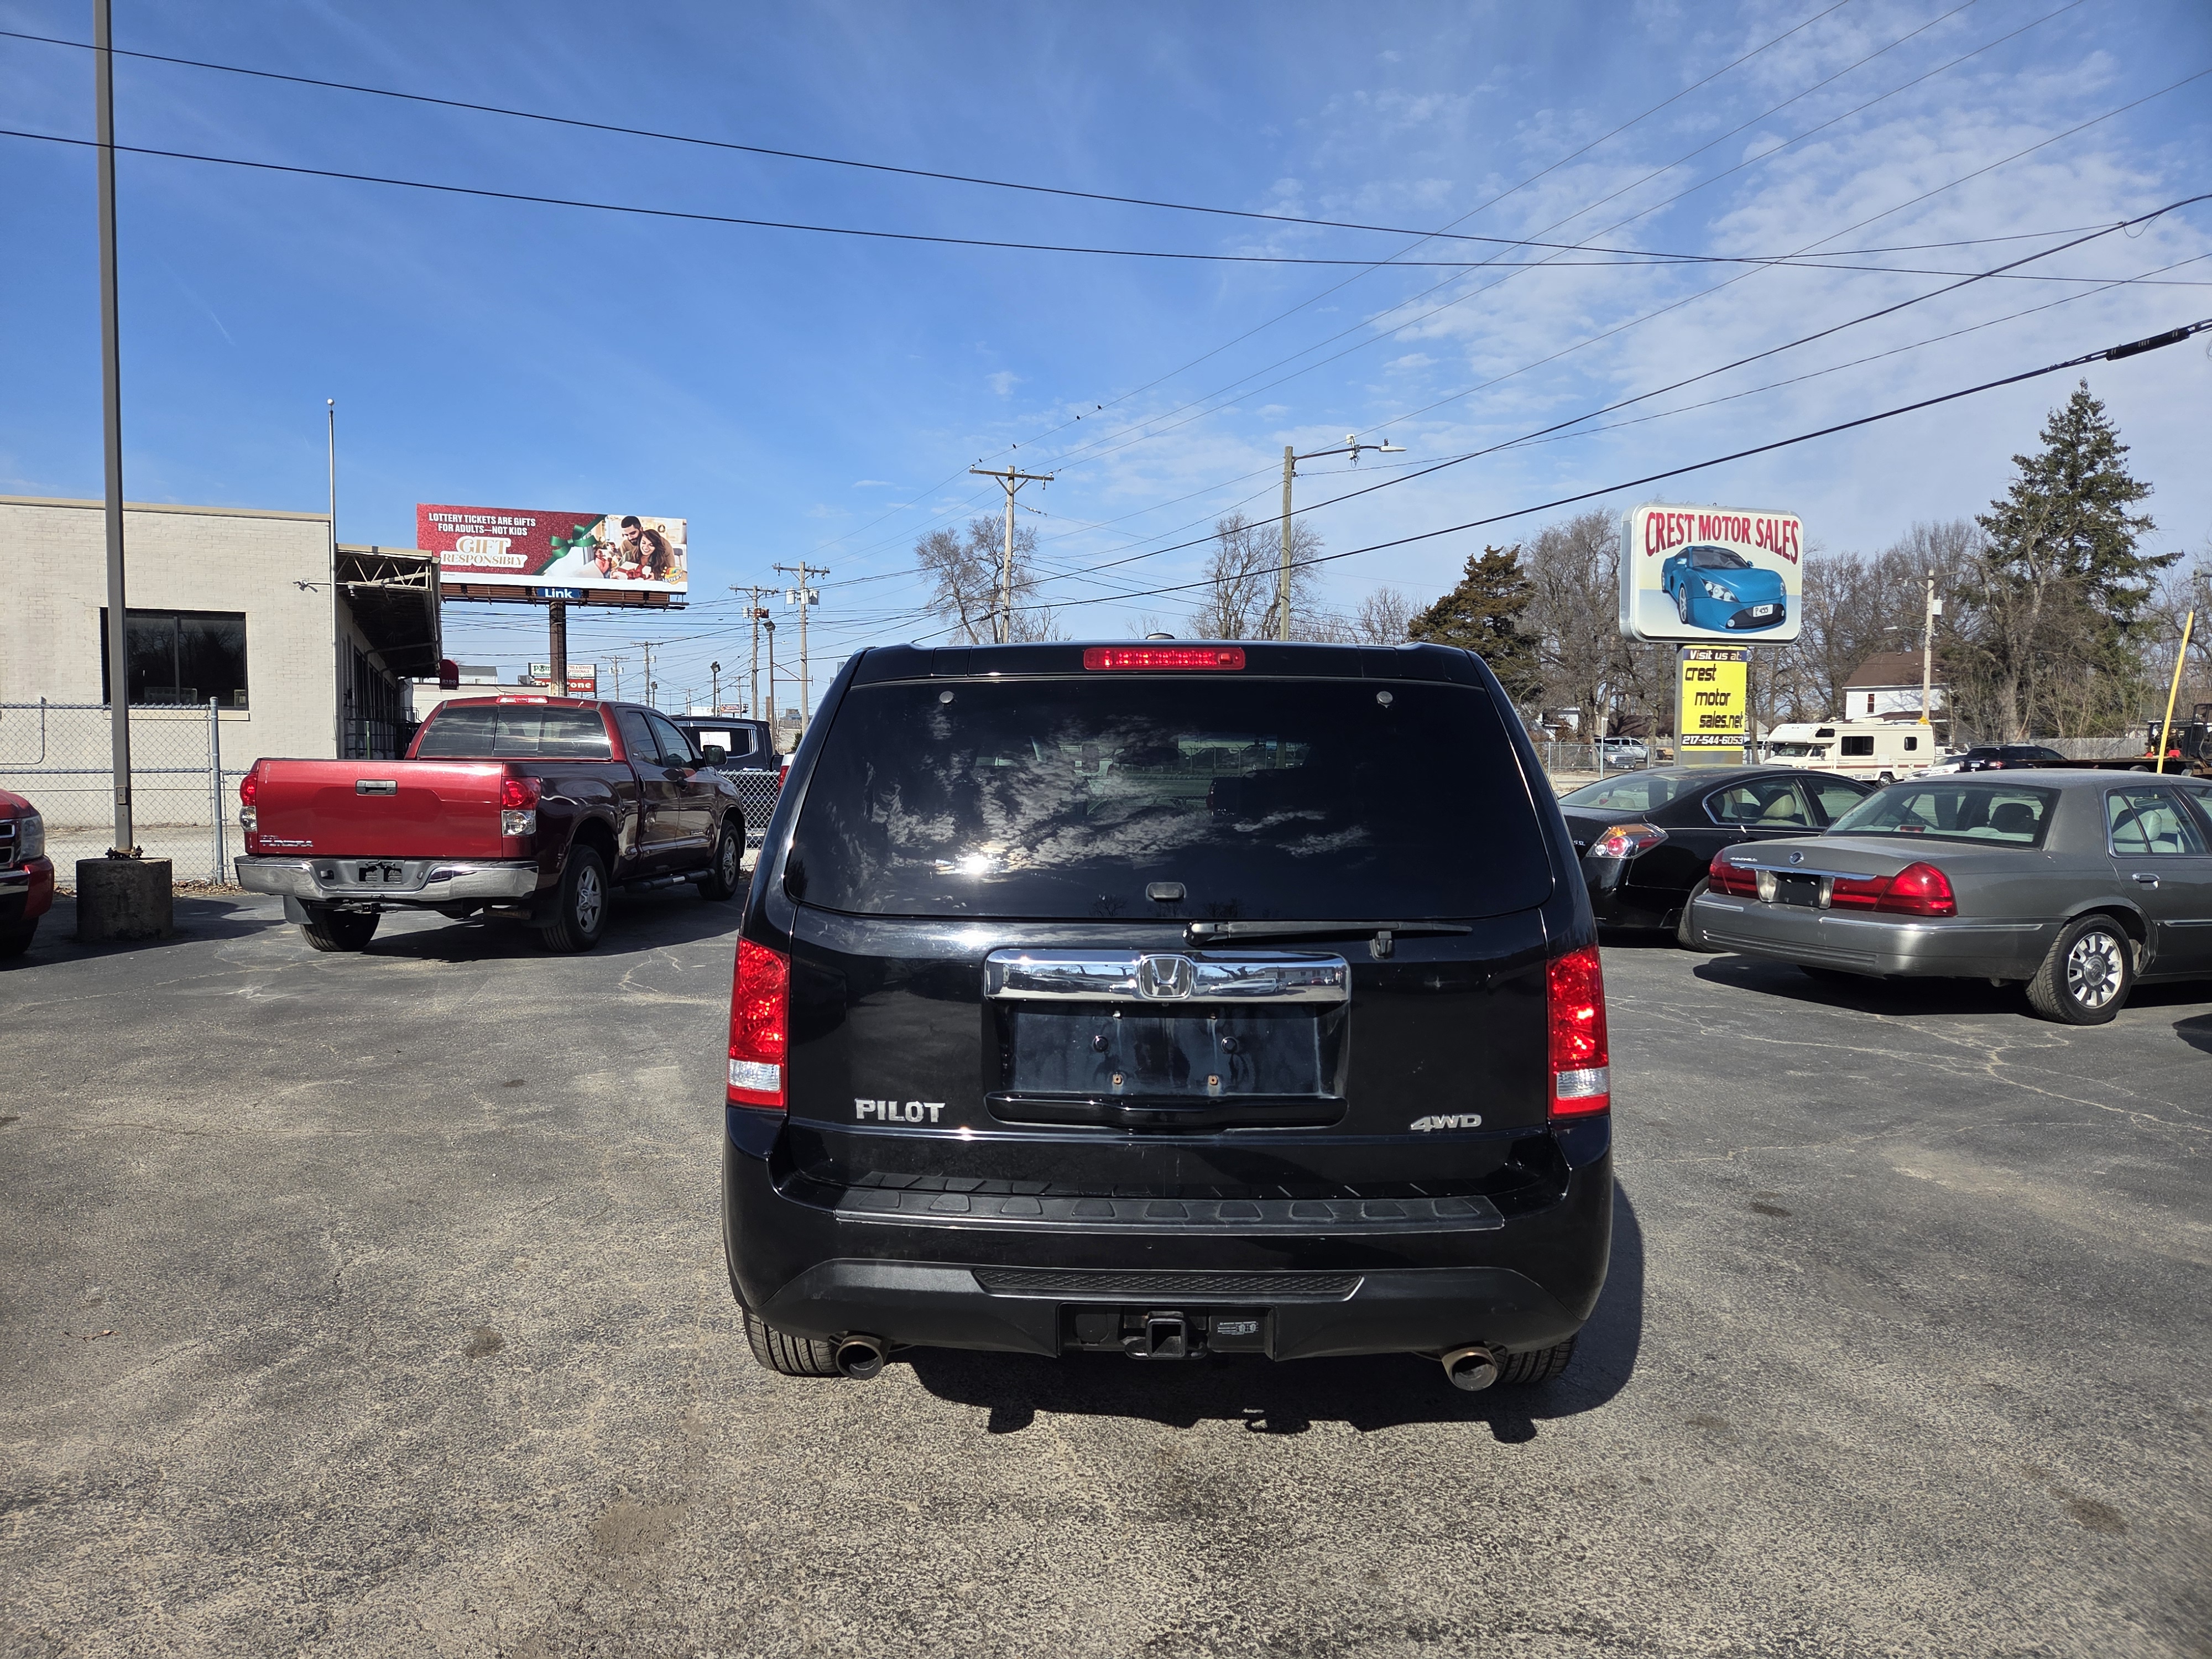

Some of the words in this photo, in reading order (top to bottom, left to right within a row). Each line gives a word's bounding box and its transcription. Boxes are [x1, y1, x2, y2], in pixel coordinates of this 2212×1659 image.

[429, 513, 463, 523] LOTTERY
[464, 515, 497, 524] TICKETS
[497, 517, 513, 525] ARE
[514, 518, 536, 526] GIFTS
[438, 523, 454, 532] FOR
[509, 527, 528, 536] KIDS
[1645, 512, 1695, 557] CREST
[1698, 514, 1751, 545] MOTOR
[1755, 518, 1798, 565] SALES
[459, 538, 508, 555] GIFT
[443, 554, 524, 566] RESPONSIBLY
[662, 573, 682, 582] LOTTERY
[545, 588, 573, 598] Link
[1690, 650, 1713, 660] Visit
[1730, 651, 1742, 660] at:
[1685, 663, 1717, 681] crest
[1694, 688, 1731, 706] motor
[1699, 711, 1744, 728] sales.net
[1682, 735, 1744, 744] 217-544-6053
[854, 1098, 946, 1123] PILOT
[1409, 1113, 1482, 1132] 4WD
